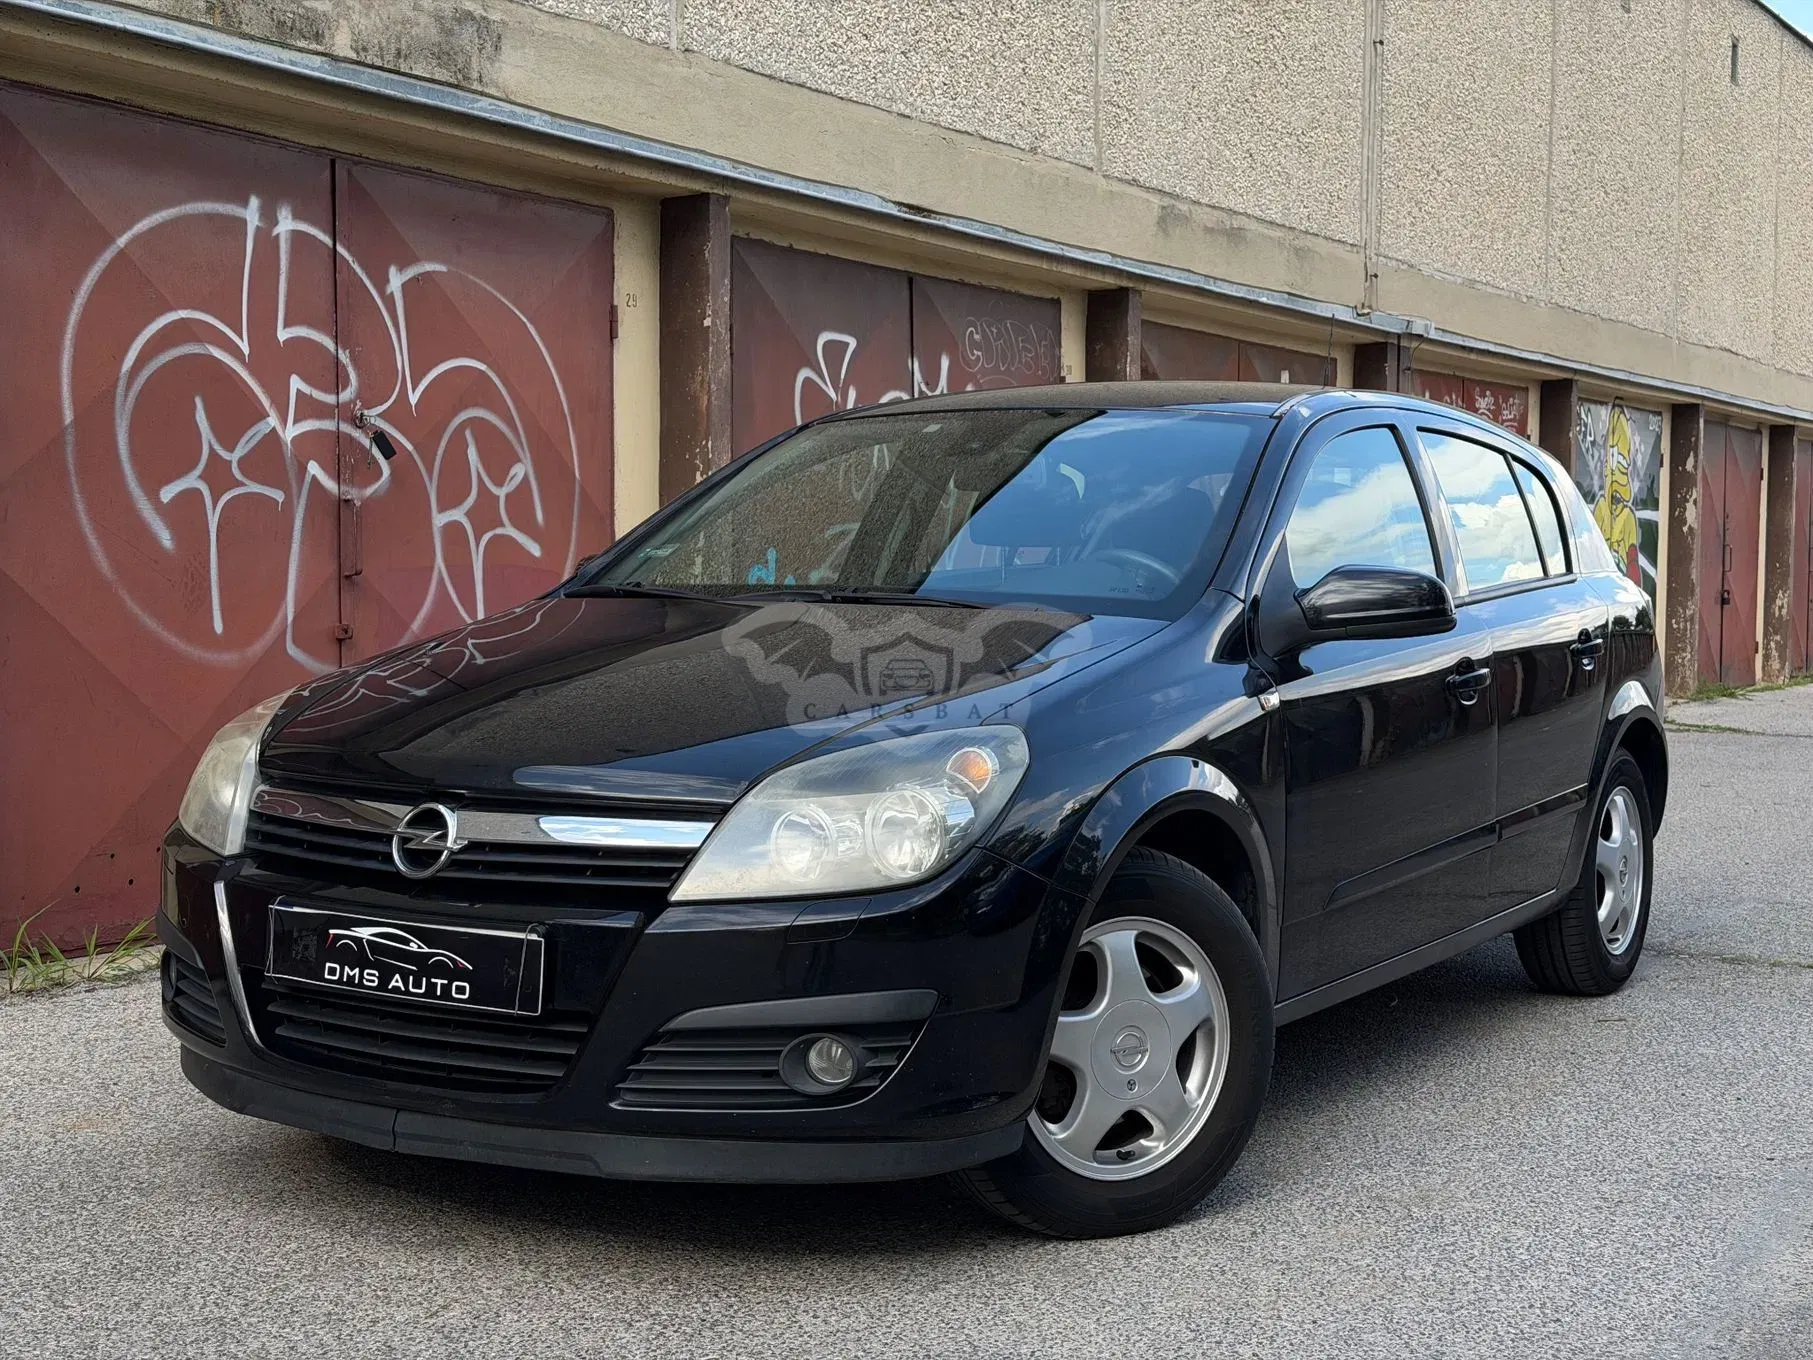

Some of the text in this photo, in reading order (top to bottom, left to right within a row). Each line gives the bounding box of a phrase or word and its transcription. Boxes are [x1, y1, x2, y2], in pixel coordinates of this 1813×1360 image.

[626, 293, 638, 308] 29
[325, 963, 470, 999] DMS AUTO
